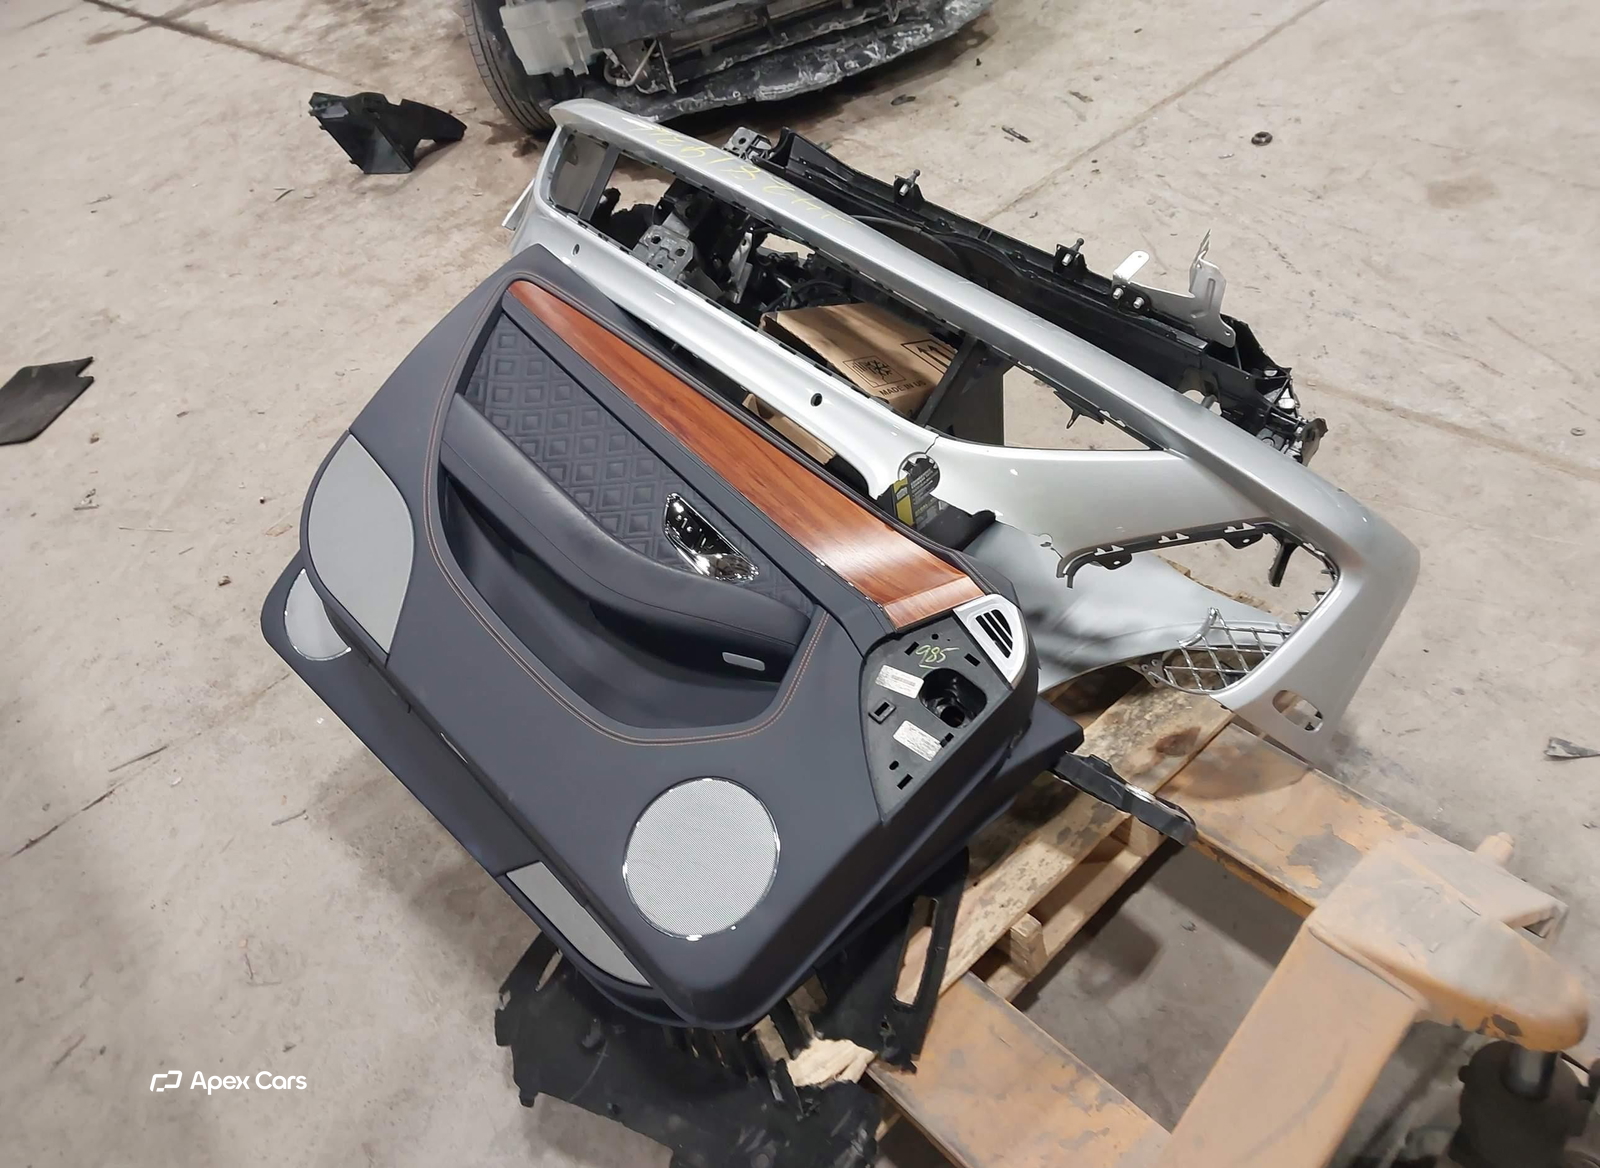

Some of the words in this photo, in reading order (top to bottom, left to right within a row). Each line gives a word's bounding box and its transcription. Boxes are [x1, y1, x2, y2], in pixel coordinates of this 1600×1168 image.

[879, 385, 904, 397] MADE
[904, 382, 915, 391] IN
[915, 644, 960, 664] 985
